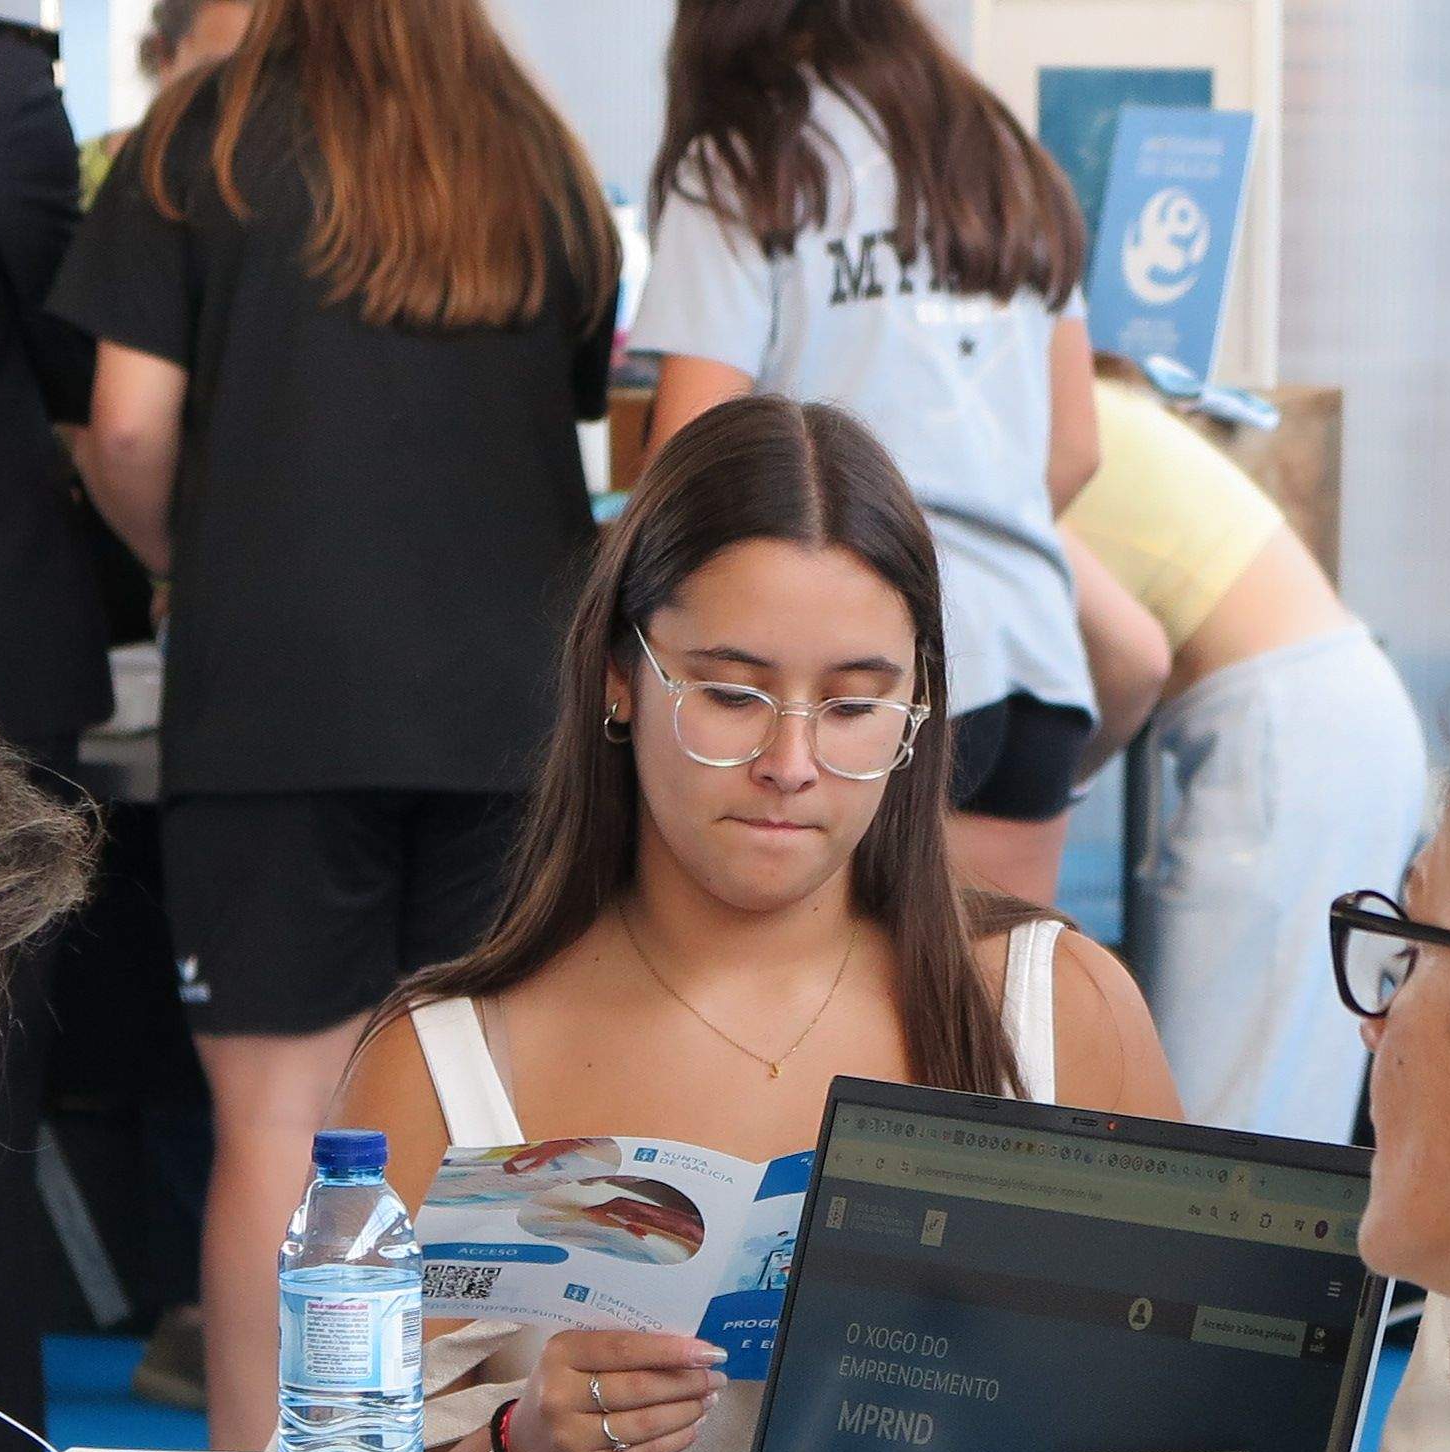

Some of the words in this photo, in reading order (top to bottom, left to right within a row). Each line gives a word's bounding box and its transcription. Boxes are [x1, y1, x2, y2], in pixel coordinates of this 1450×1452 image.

[659, 1157, 674, 1166] DE
[681, 1162, 735, 1185] GALICIA
[661, 1151, 709, 1168] XUNTA
[457, 1246, 519, 1257] ACCESO
[596, 1303, 648, 1334] GALICIA
[599, 1292, 664, 1331] EMPREGO
[846, 1322, 861, 1345] O
[864, 1325, 917, 1354] XOGO
[921, 1335, 949, 1359] DO
[838, 1355, 1000, 1402] EMPRENDEMENTO
[836, 1400, 935, 1446] MPRND
